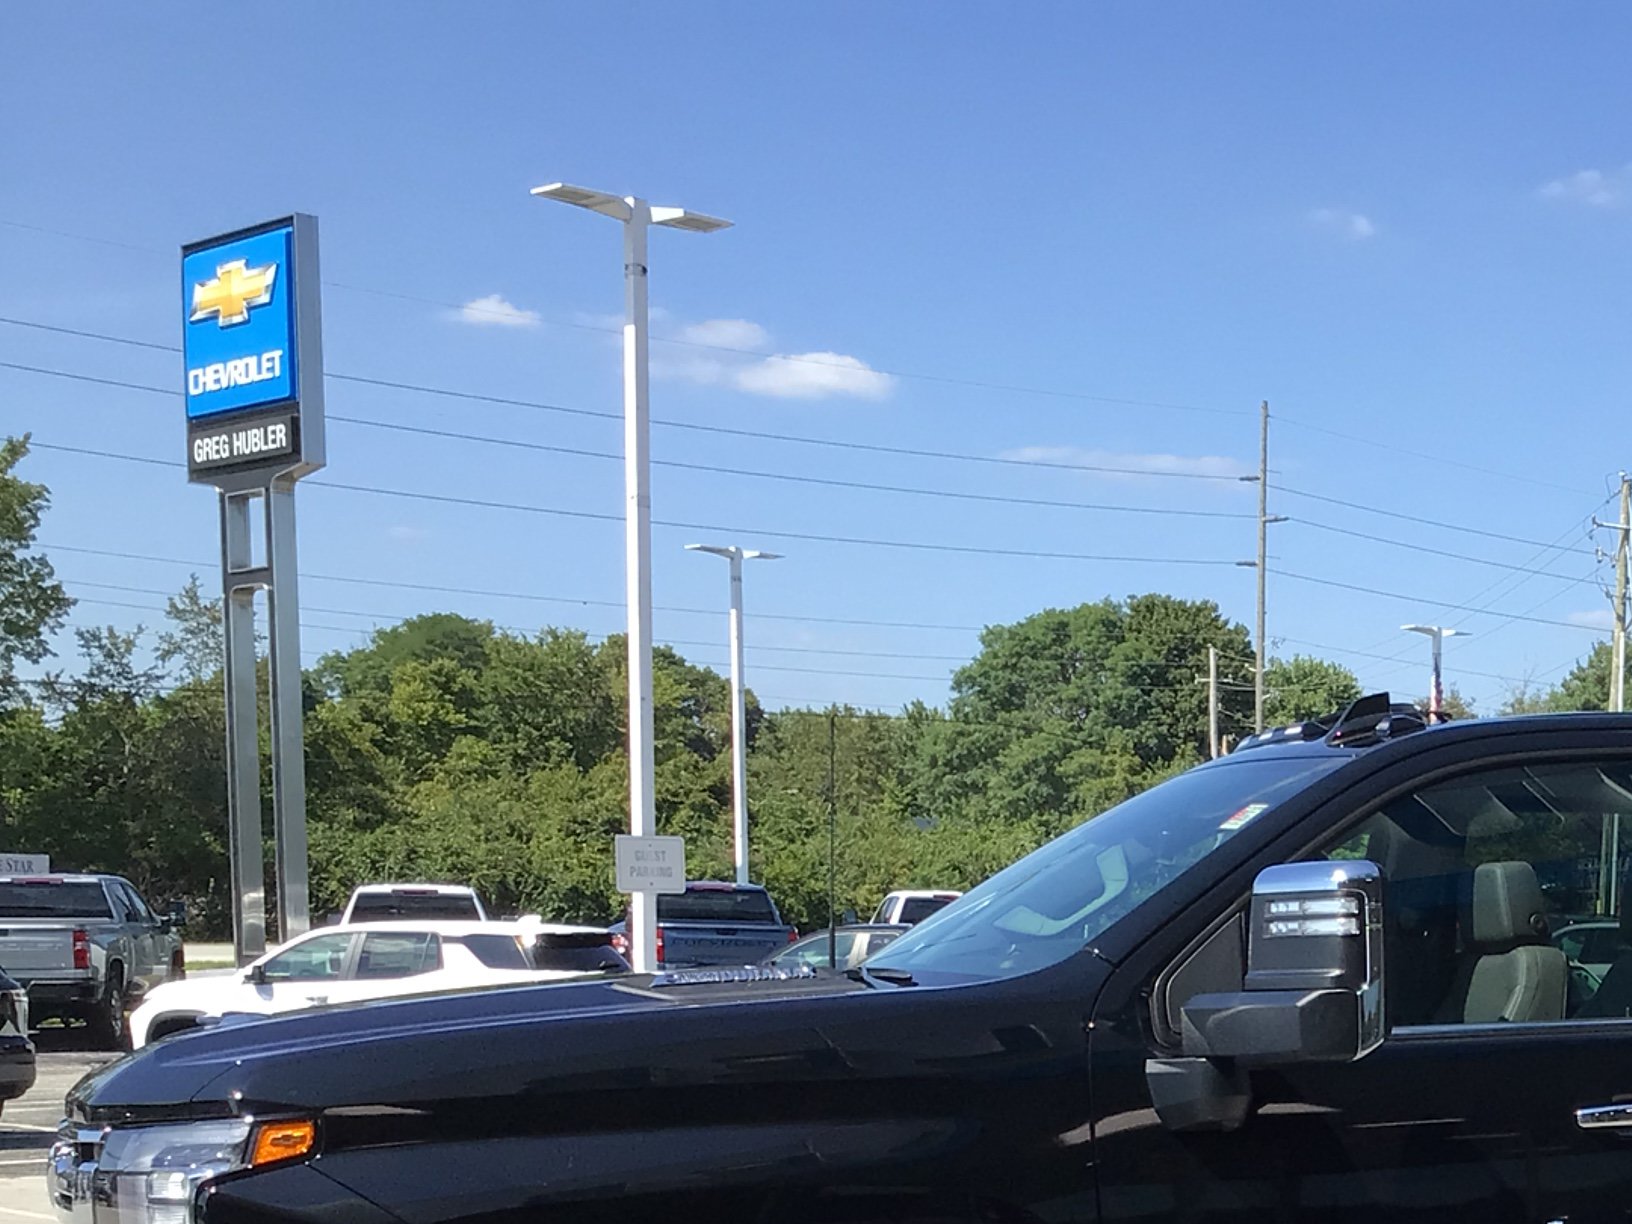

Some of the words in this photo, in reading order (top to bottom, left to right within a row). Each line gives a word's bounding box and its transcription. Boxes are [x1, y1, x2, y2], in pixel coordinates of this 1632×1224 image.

[188, 350, 283, 395] CHEVROLET
[194, 433, 229, 463] GREG
[233, 424, 287, 456] HUBLER
[6, 858, 34, 872] STAR
[629, 866, 673, 878] PARKING
